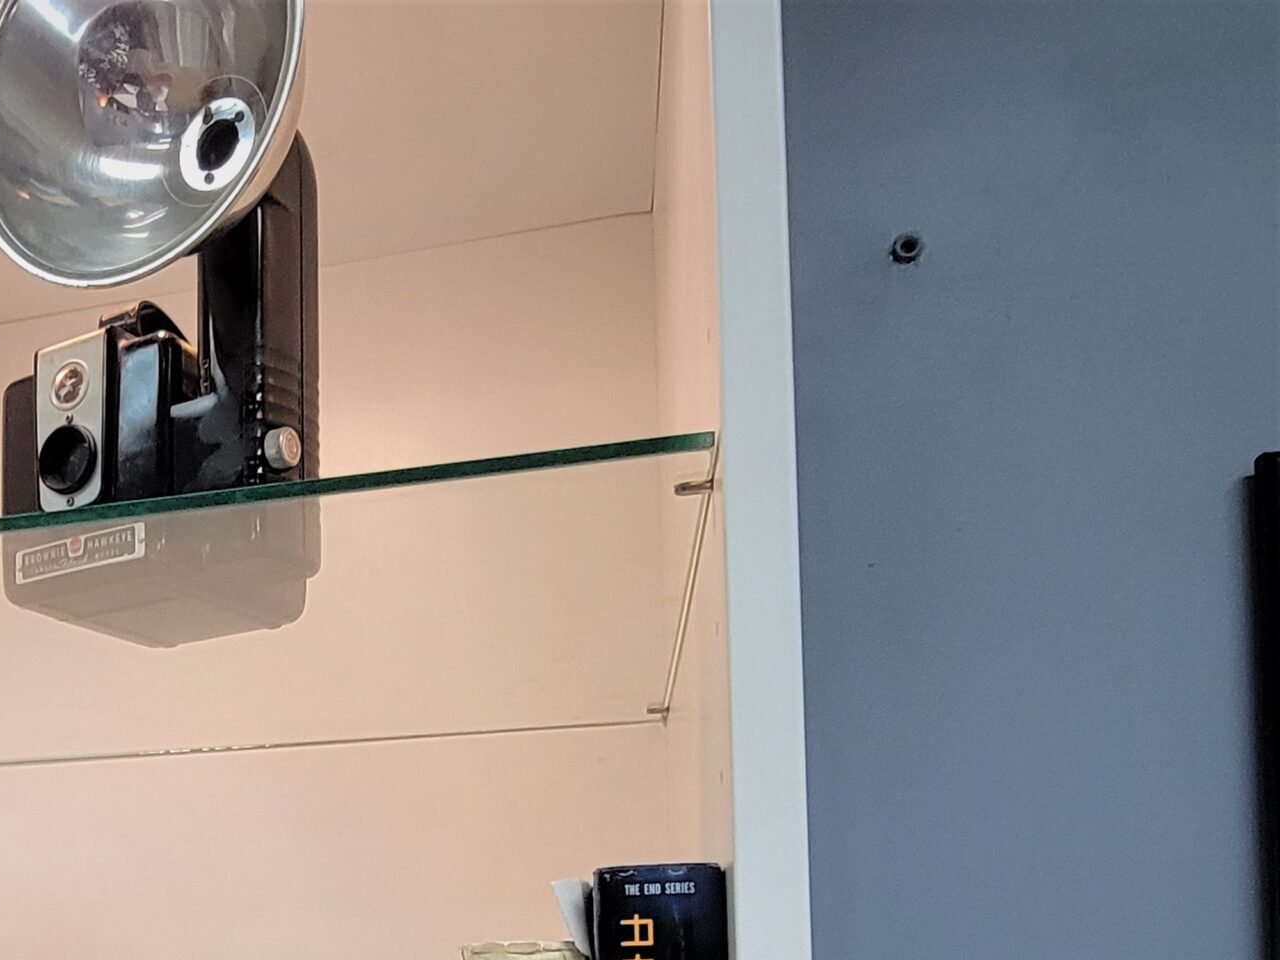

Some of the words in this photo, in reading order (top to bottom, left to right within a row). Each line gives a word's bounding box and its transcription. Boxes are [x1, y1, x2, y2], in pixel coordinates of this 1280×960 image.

[24, 546, 65, 566] BROWNIE
[87, 531, 132, 549] HAWKEYE
[624, 883, 640, 895] THE
[643, 882, 661, 894] END
[664, 881, 696, 894] SERIES
